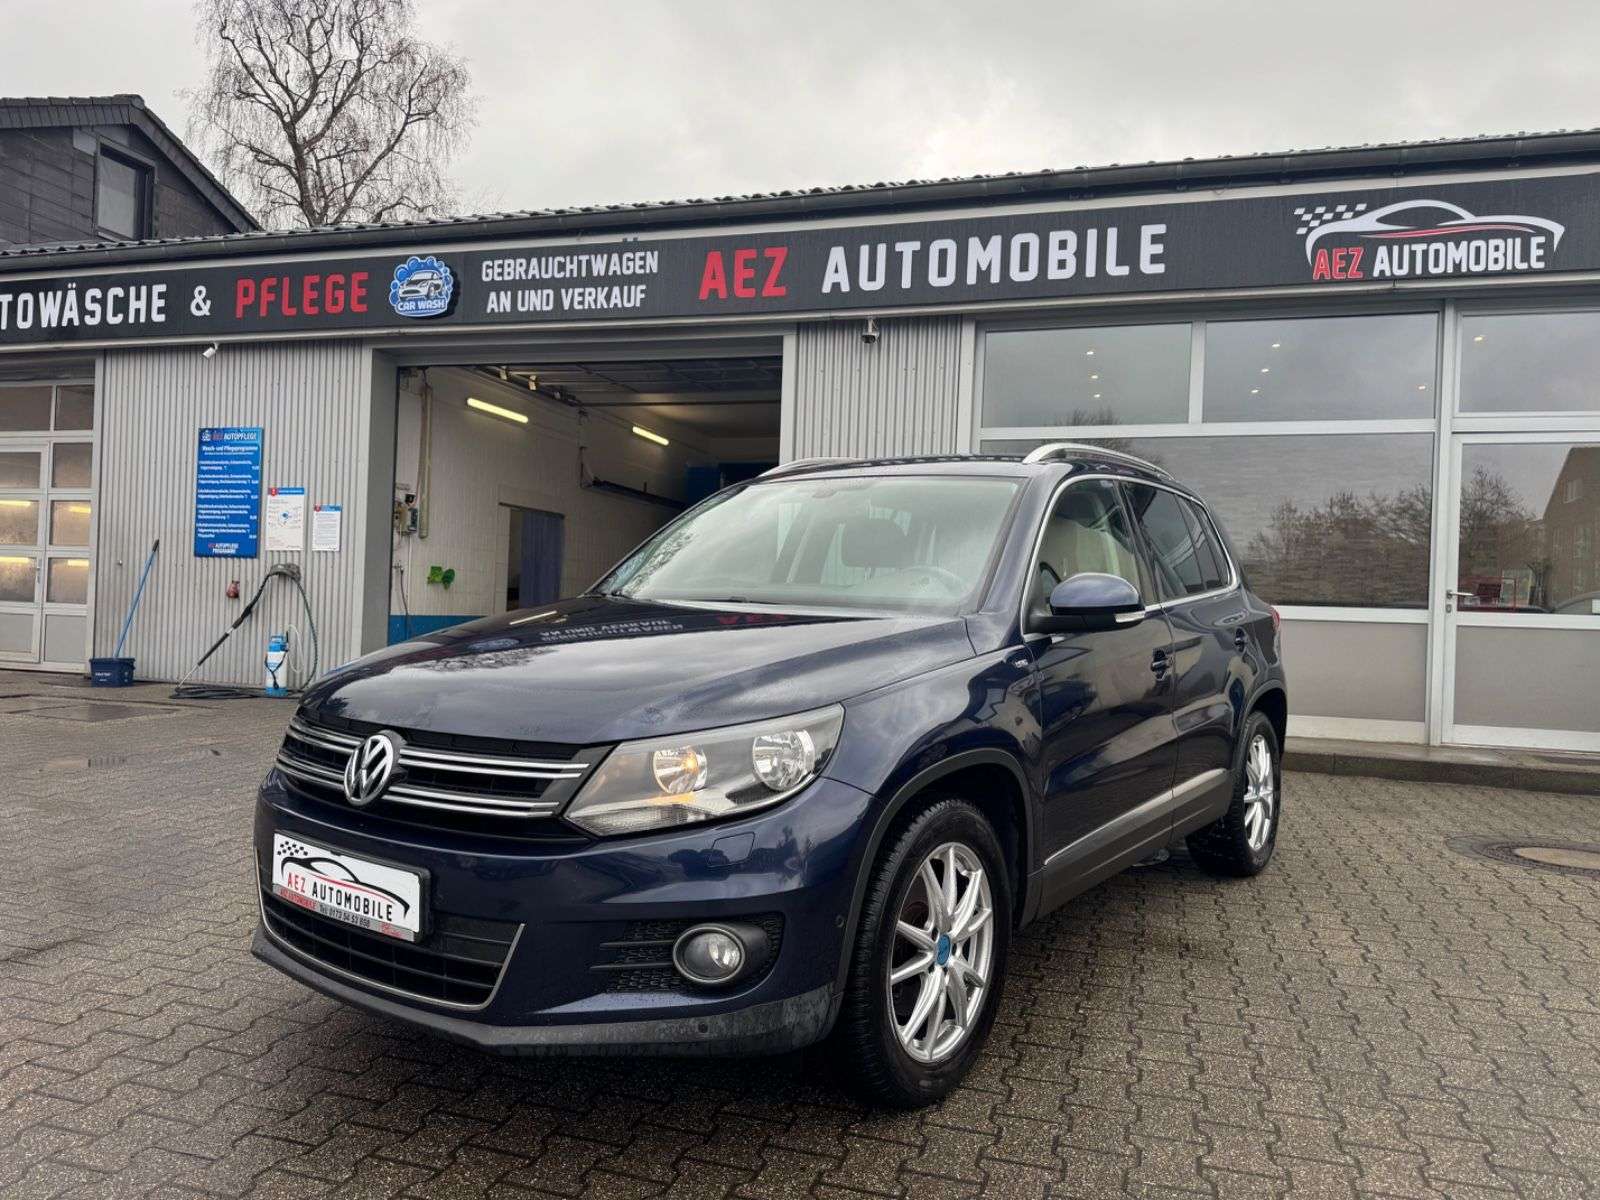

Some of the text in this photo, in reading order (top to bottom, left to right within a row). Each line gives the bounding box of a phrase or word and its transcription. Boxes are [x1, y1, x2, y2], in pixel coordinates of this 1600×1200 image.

[481, 251, 659, 282] GEBRAUCHTWAGEN
[699, 224, 1167, 300] AEZ AUTOMOBILE
[1313, 236, 1546, 280] AEZ AUTOMOBILE
[190, 285, 212, 317] &
[235, 271, 369, 319] PFLEGE
[398, 299, 445, 310] CAR WASH
[486, 284, 647, 314] AN UND VERKAUF
[287, 872, 392, 922] AEZ AUTOMOBILE
